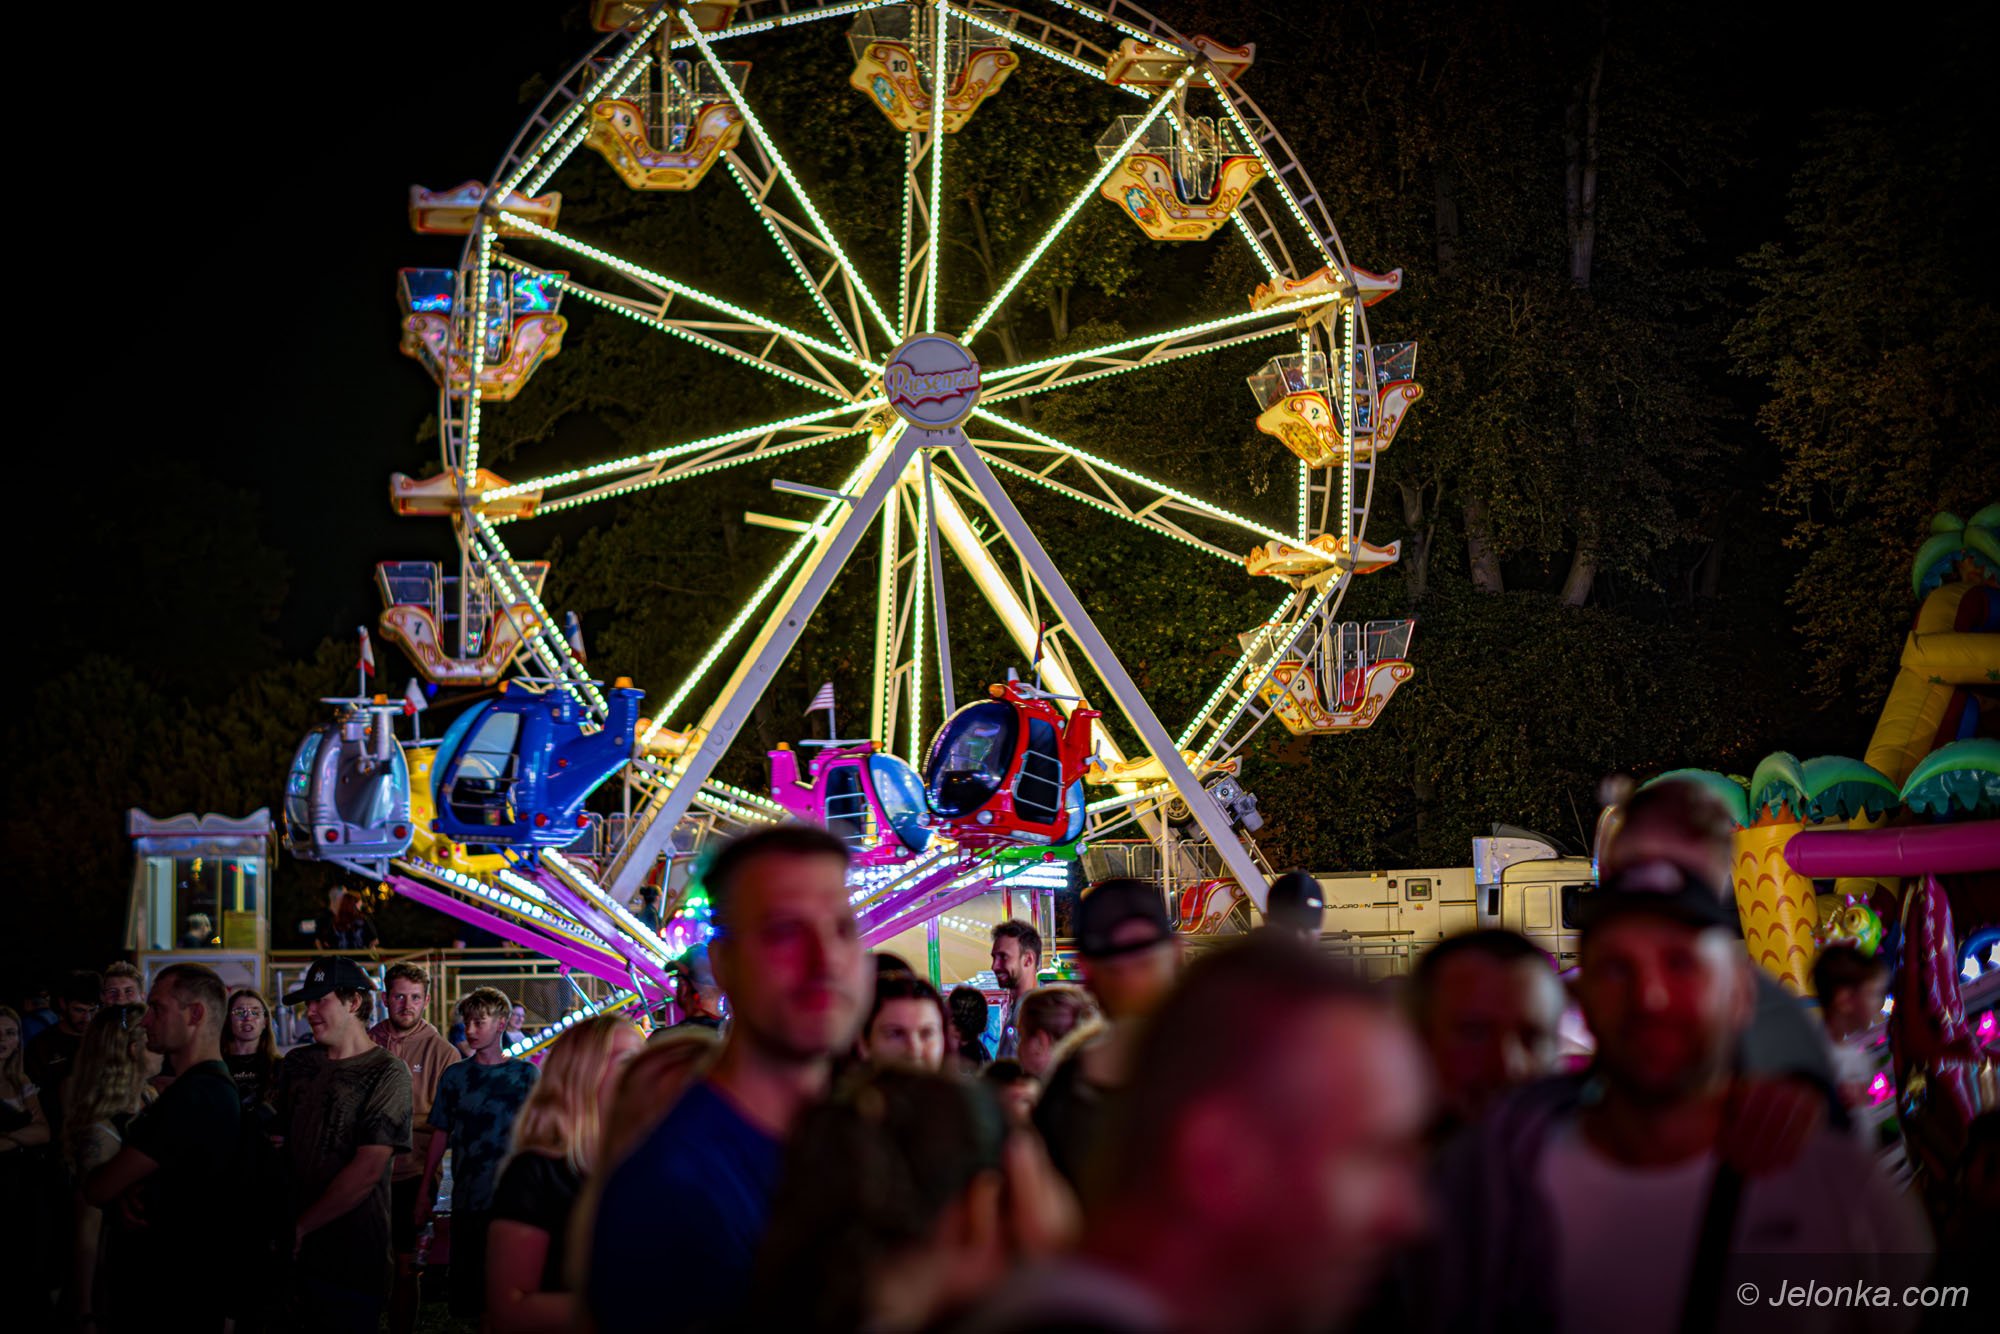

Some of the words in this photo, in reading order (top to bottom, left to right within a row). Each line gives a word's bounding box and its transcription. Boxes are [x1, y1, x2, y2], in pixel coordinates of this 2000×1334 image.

[892, 60, 907, 72] 10
[622, 115, 631, 127] 9
[1153, 171, 1160, 183] 1
[1311, 408, 1320, 420] 2
[414, 621, 422, 635] 7
[1297, 680, 1305, 691] 3
